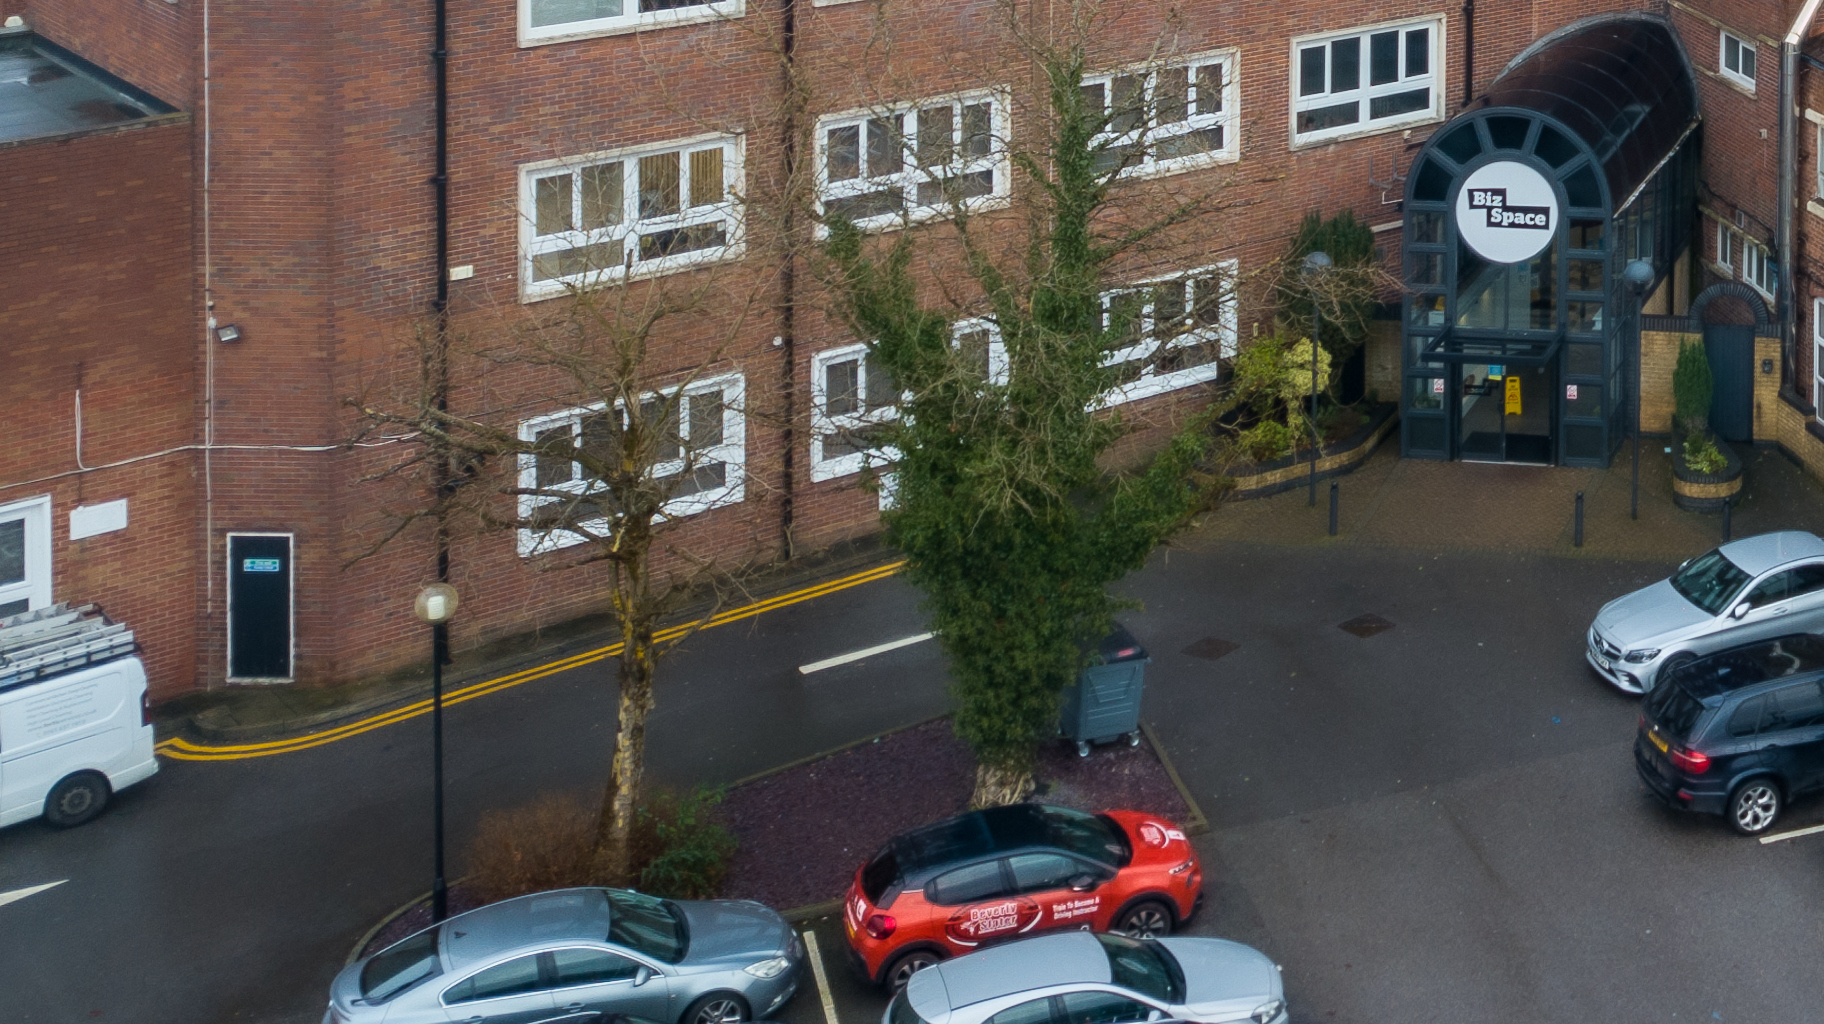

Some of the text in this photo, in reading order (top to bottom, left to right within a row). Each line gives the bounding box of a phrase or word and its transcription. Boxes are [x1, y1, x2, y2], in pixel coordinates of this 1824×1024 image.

[1472, 191, 1503, 207] Biz
[1490, 207, 1547, 226] Space
[971, 902, 1018, 921] Beverly
